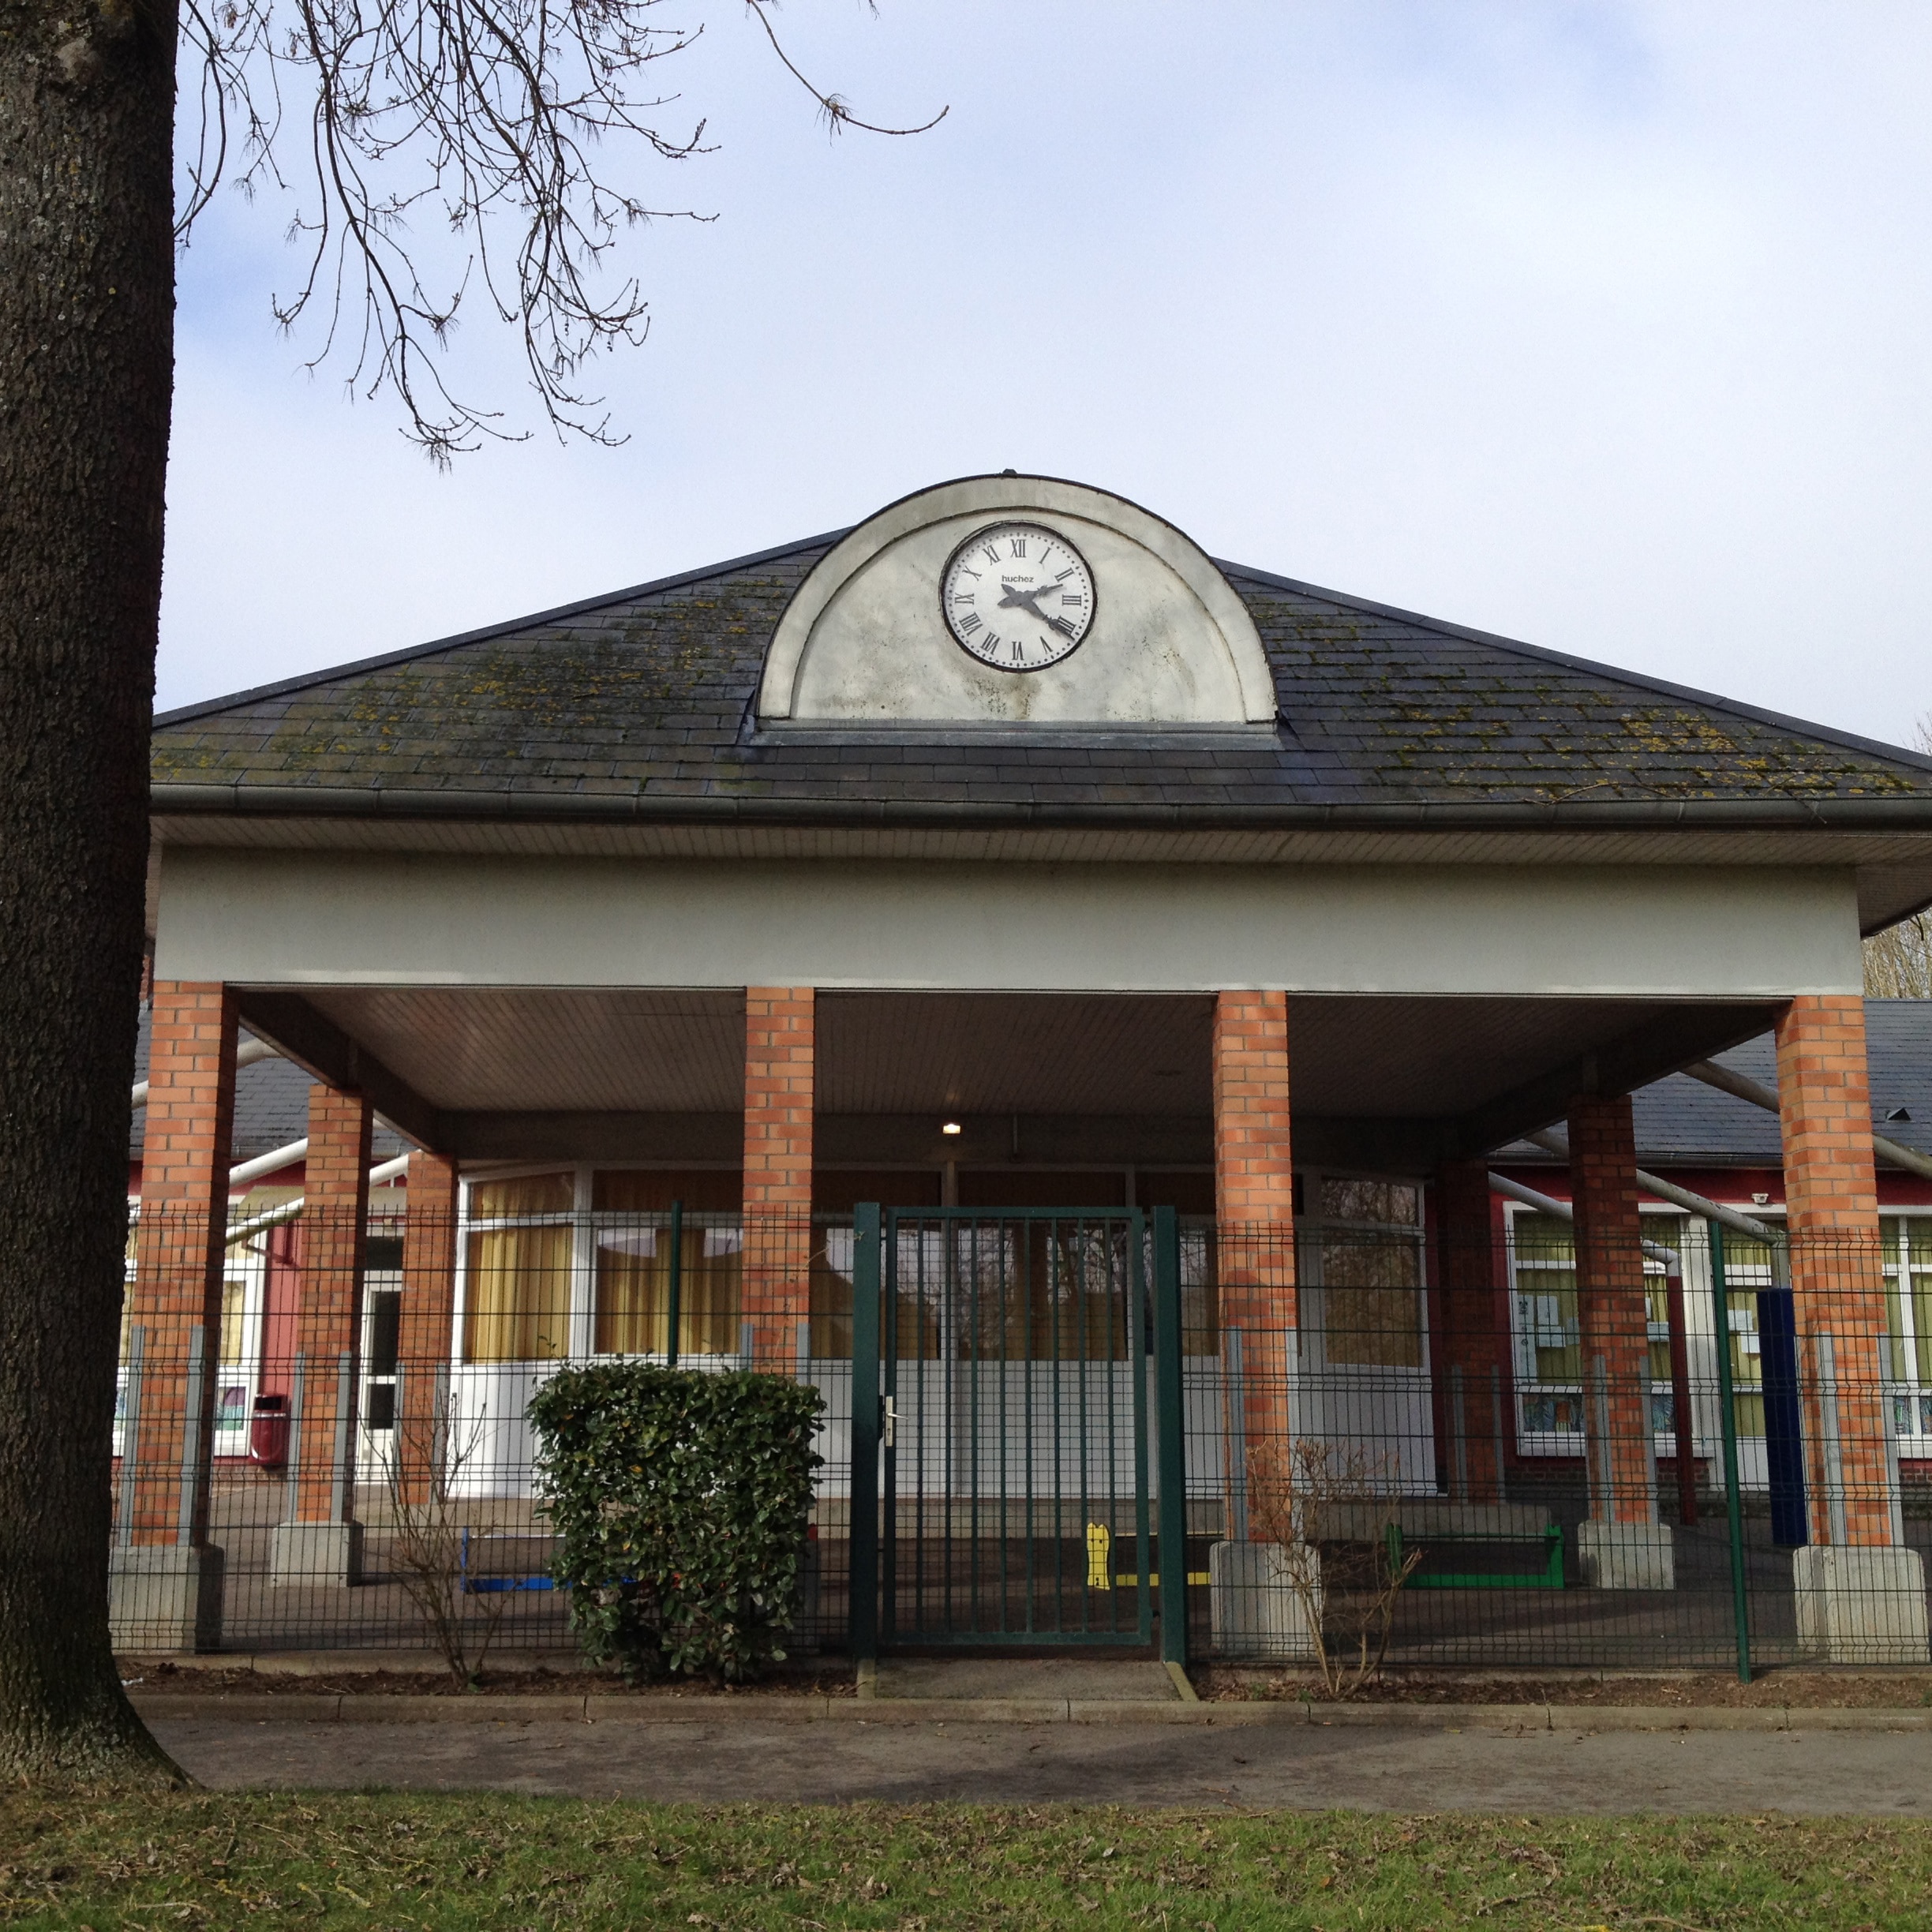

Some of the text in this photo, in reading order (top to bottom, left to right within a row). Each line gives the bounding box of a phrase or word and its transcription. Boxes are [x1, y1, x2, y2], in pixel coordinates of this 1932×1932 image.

[983, 545, 1002, 566] XI
[1010, 539, 1027, 558] XII
[1039, 547, 1052, 564] I
[962, 565, 983, 582] X
[1054, 567, 1075, 582] II
[954, 593, 975, 605] IX
[1061, 593, 1082, 607] III
[959, 612, 983, 637] VIII
[979, 631, 1000, 655] VII
[1012, 641, 1024, 661] VI
[1039, 635, 1053, 655] V
